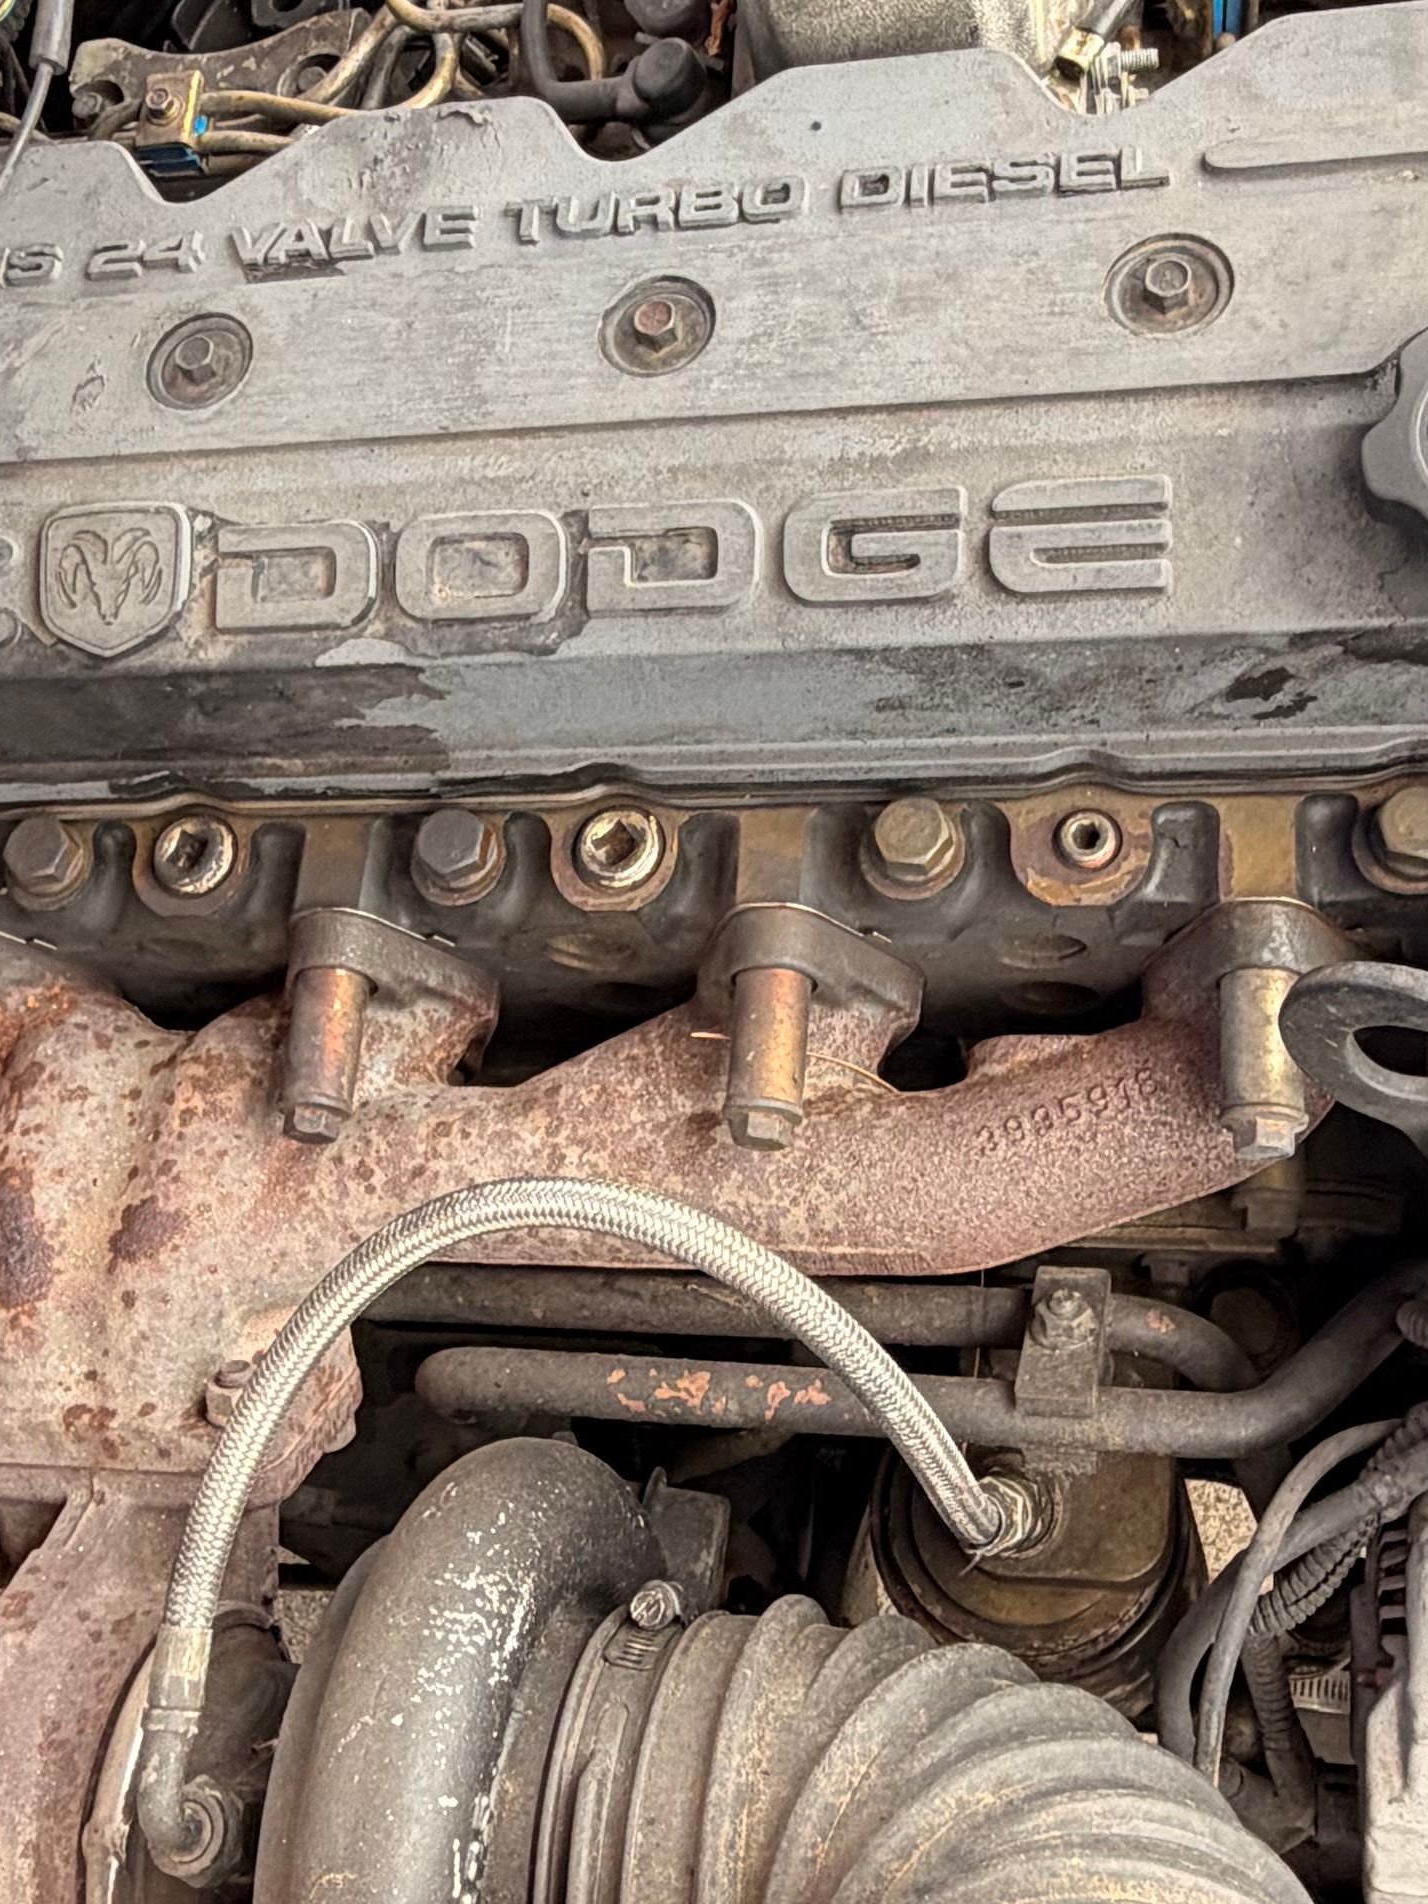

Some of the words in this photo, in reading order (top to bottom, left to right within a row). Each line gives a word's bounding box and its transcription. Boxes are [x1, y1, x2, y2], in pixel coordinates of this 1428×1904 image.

[85, 228, 206, 282] 24
[231, 203, 481, 280] VALVE
[506, 172, 810, 246] TURBO
[839, 144, 1172, 211] DIESEL
[210, 472, 1174, 636] DODGE
